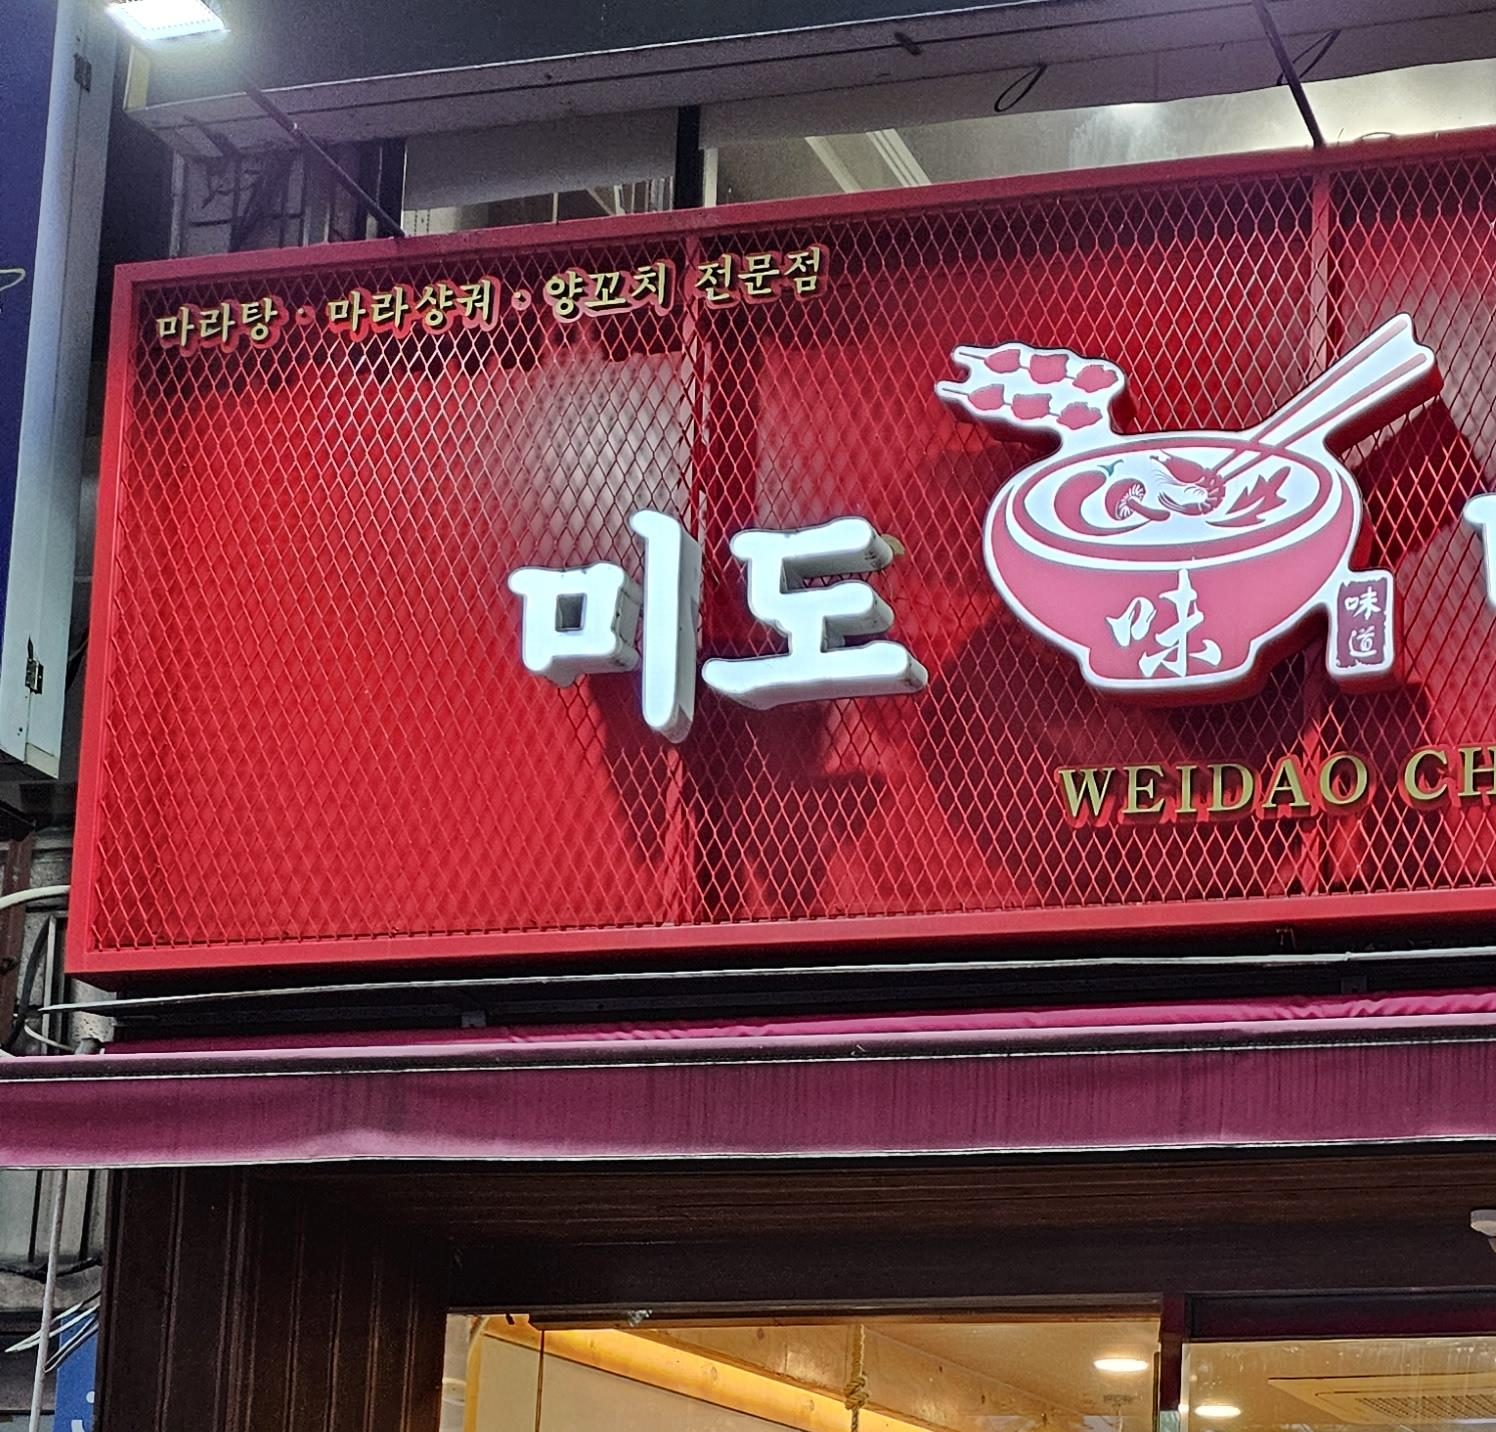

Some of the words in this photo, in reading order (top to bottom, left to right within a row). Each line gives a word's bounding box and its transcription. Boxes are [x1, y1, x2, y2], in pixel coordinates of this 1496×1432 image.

[156, 297, 278, 347] 마라탕
[327, 280, 495, 333] 마라샹궈
[545, 262, 667, 315] 양꼬치
[696, 245, 823, 301] 전문점
[507, 509, 929, 744] 미도
[1108, 558, 1221, 679] 味
[1344, 589, 1383, 660] 味道
[1058, 752, 1370, 820] WEIDAO
